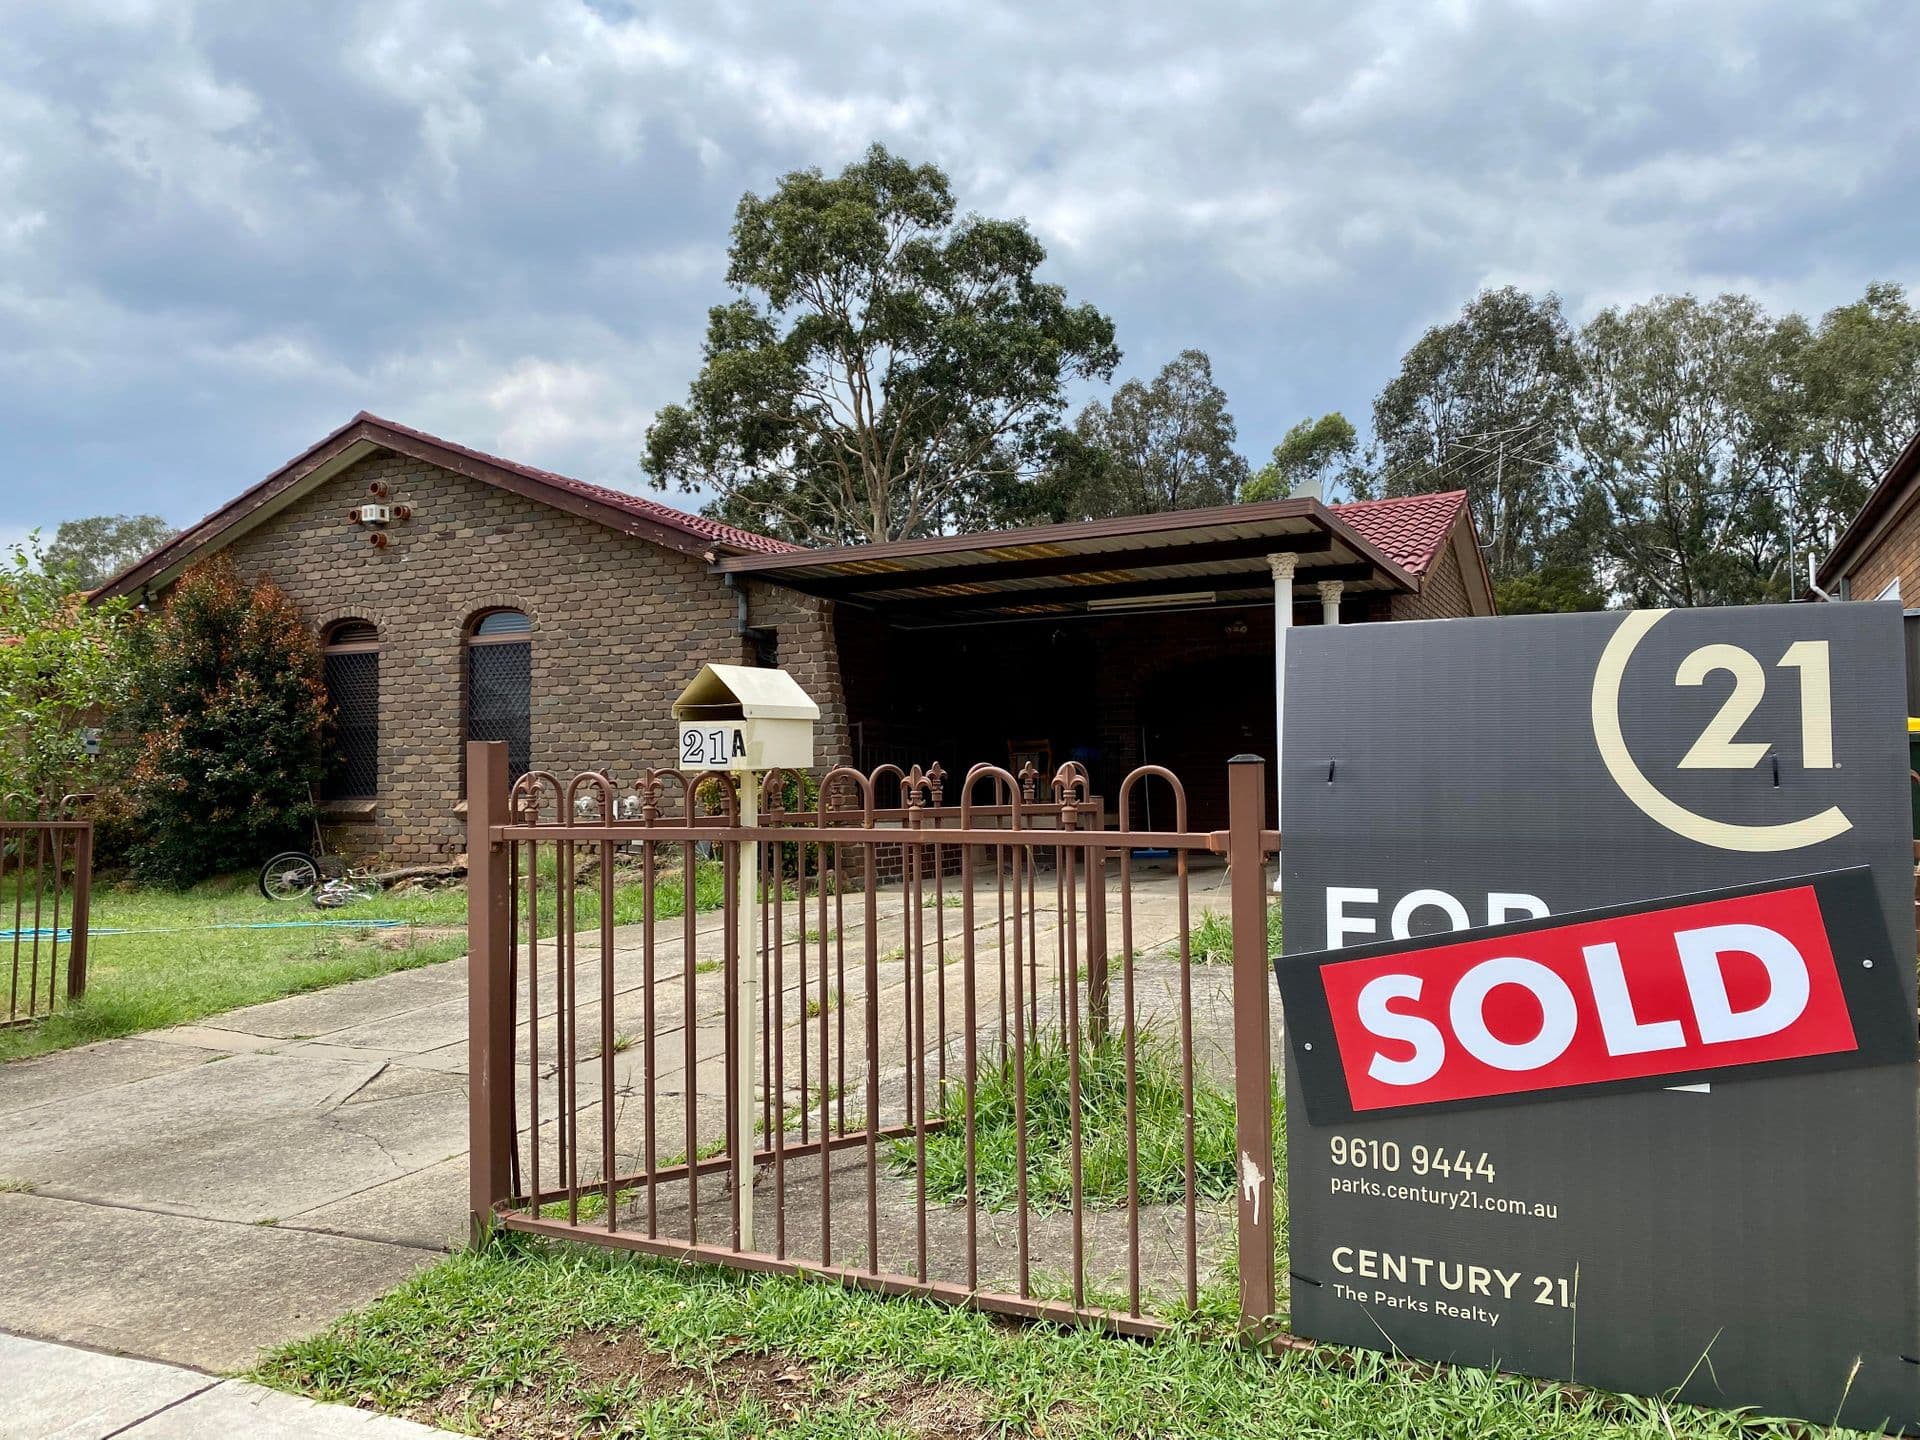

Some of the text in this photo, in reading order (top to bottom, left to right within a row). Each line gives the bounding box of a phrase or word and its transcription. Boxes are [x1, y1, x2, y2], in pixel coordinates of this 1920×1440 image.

[1357, 924, 1811, 1086] SOLD
[1330, 1135, 1496, 1183] 9610 9444
[1330, 1176, 1558, 1219] parks.century21.com.au
[1331, 1246, 1522, 1299] CENTURY
[1333, 1284, 1500, 1327] The Parks Realty
